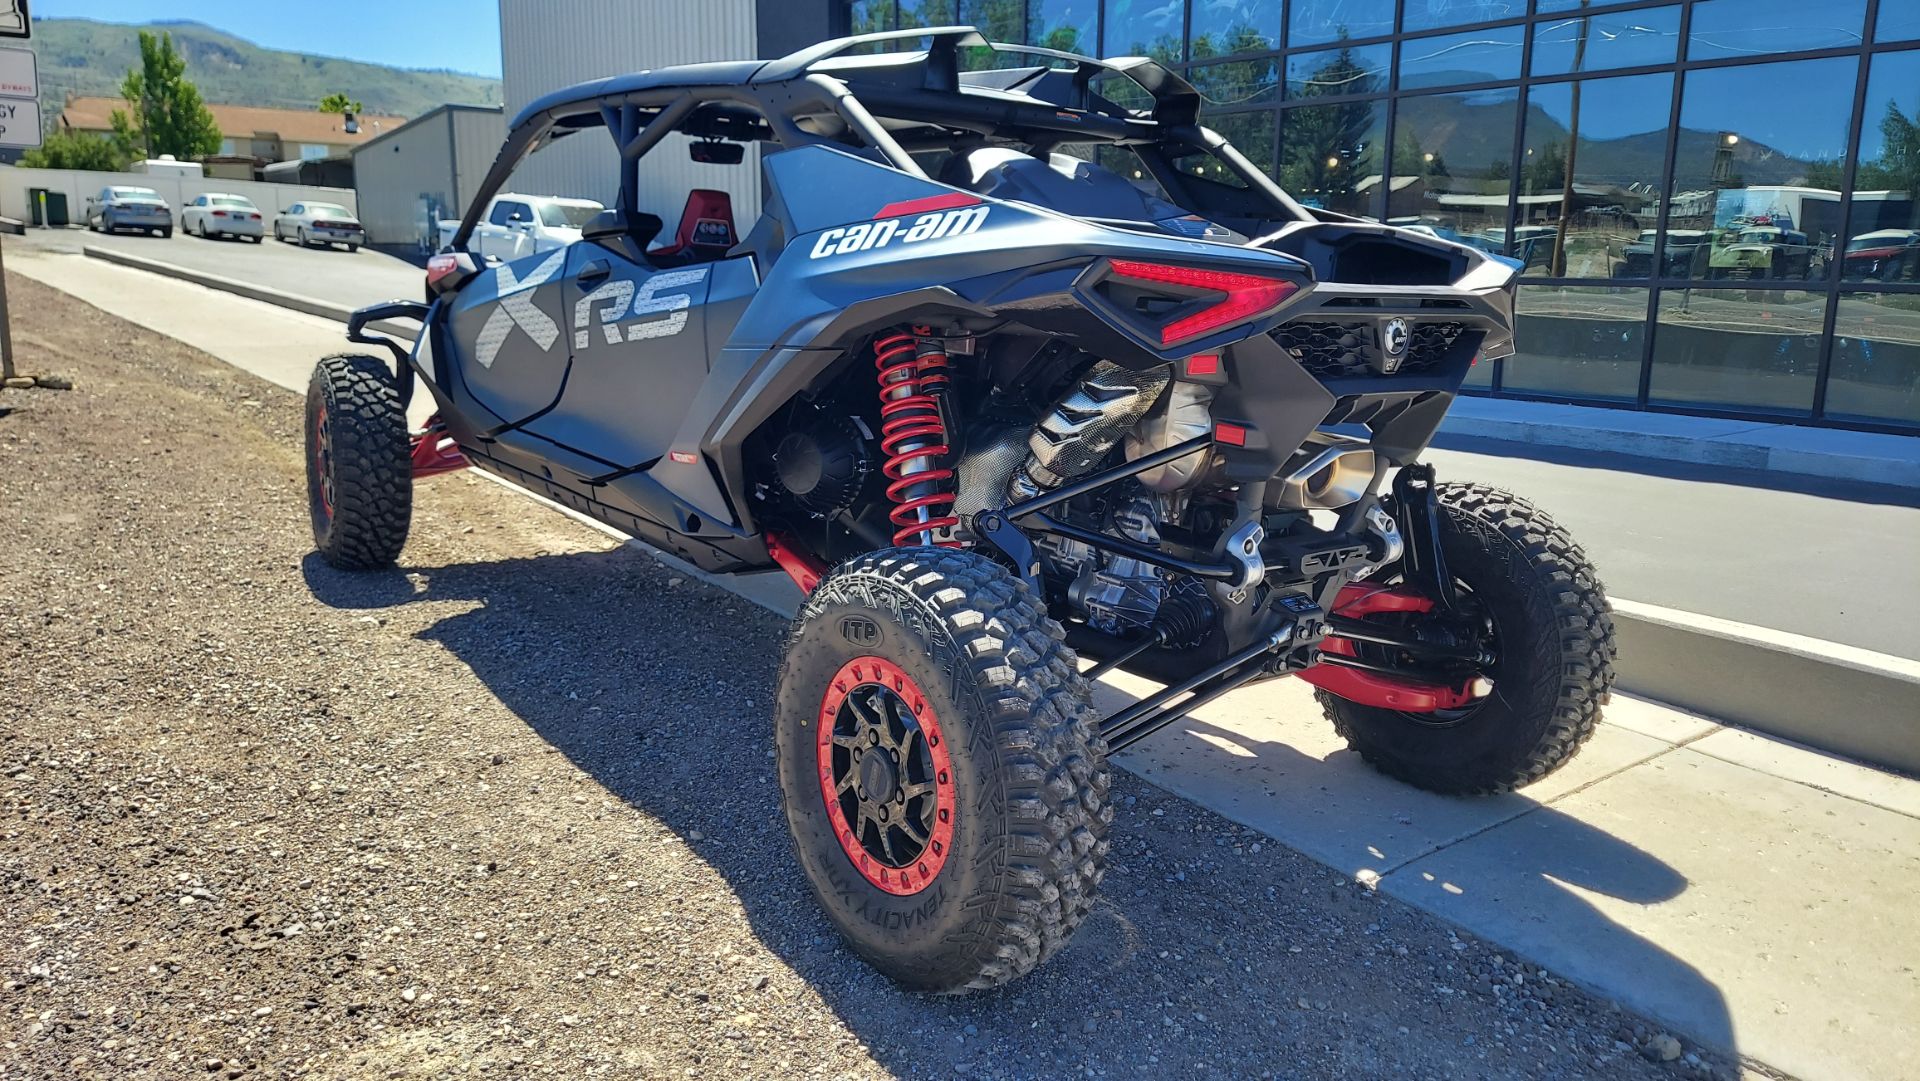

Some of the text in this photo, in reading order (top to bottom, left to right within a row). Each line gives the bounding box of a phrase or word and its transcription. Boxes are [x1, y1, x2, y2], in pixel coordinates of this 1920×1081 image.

[809, 206, 991, 260] can-am
[574, 268, 708, 350] RS
[842, 620, 878, 641] ITP
[855, 882, 947, 930] TENACITY
